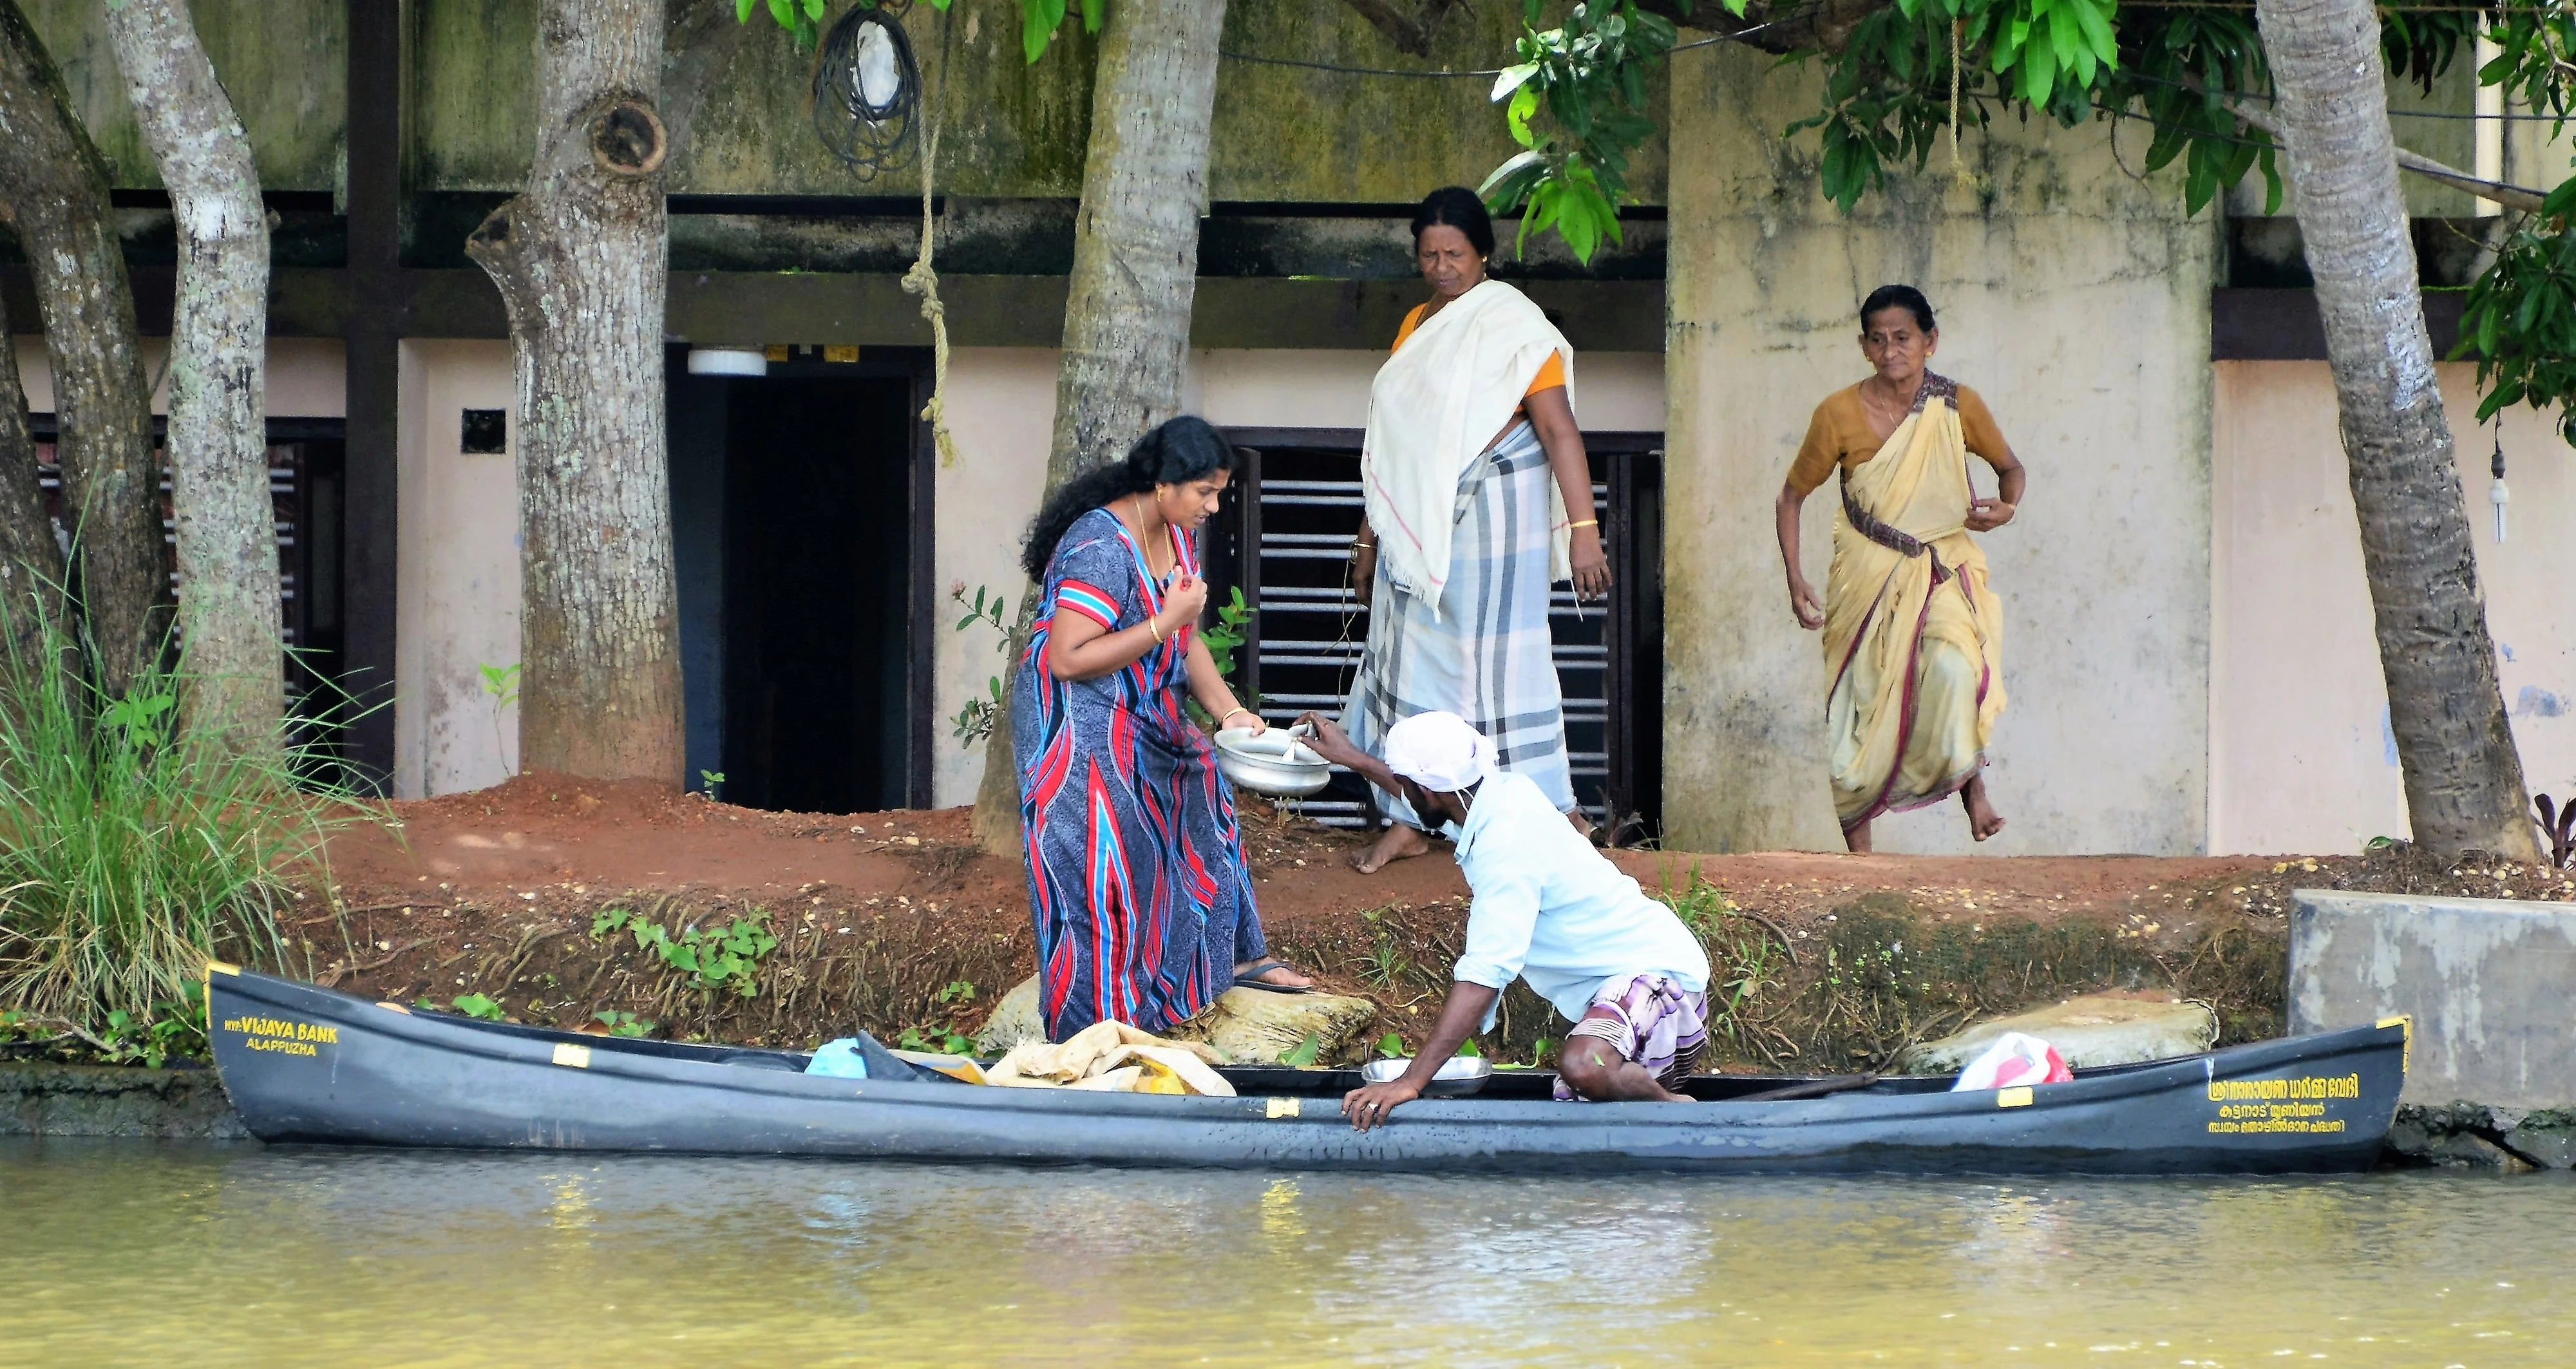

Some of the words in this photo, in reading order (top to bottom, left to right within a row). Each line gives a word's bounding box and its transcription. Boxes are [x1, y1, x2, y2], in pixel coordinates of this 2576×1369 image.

[242, 1015, 294, 1039] VIJAYA
[298, 1023, 337, 1043] BANK
[246, 1038, 316, 1056] ALAPPUZHA
